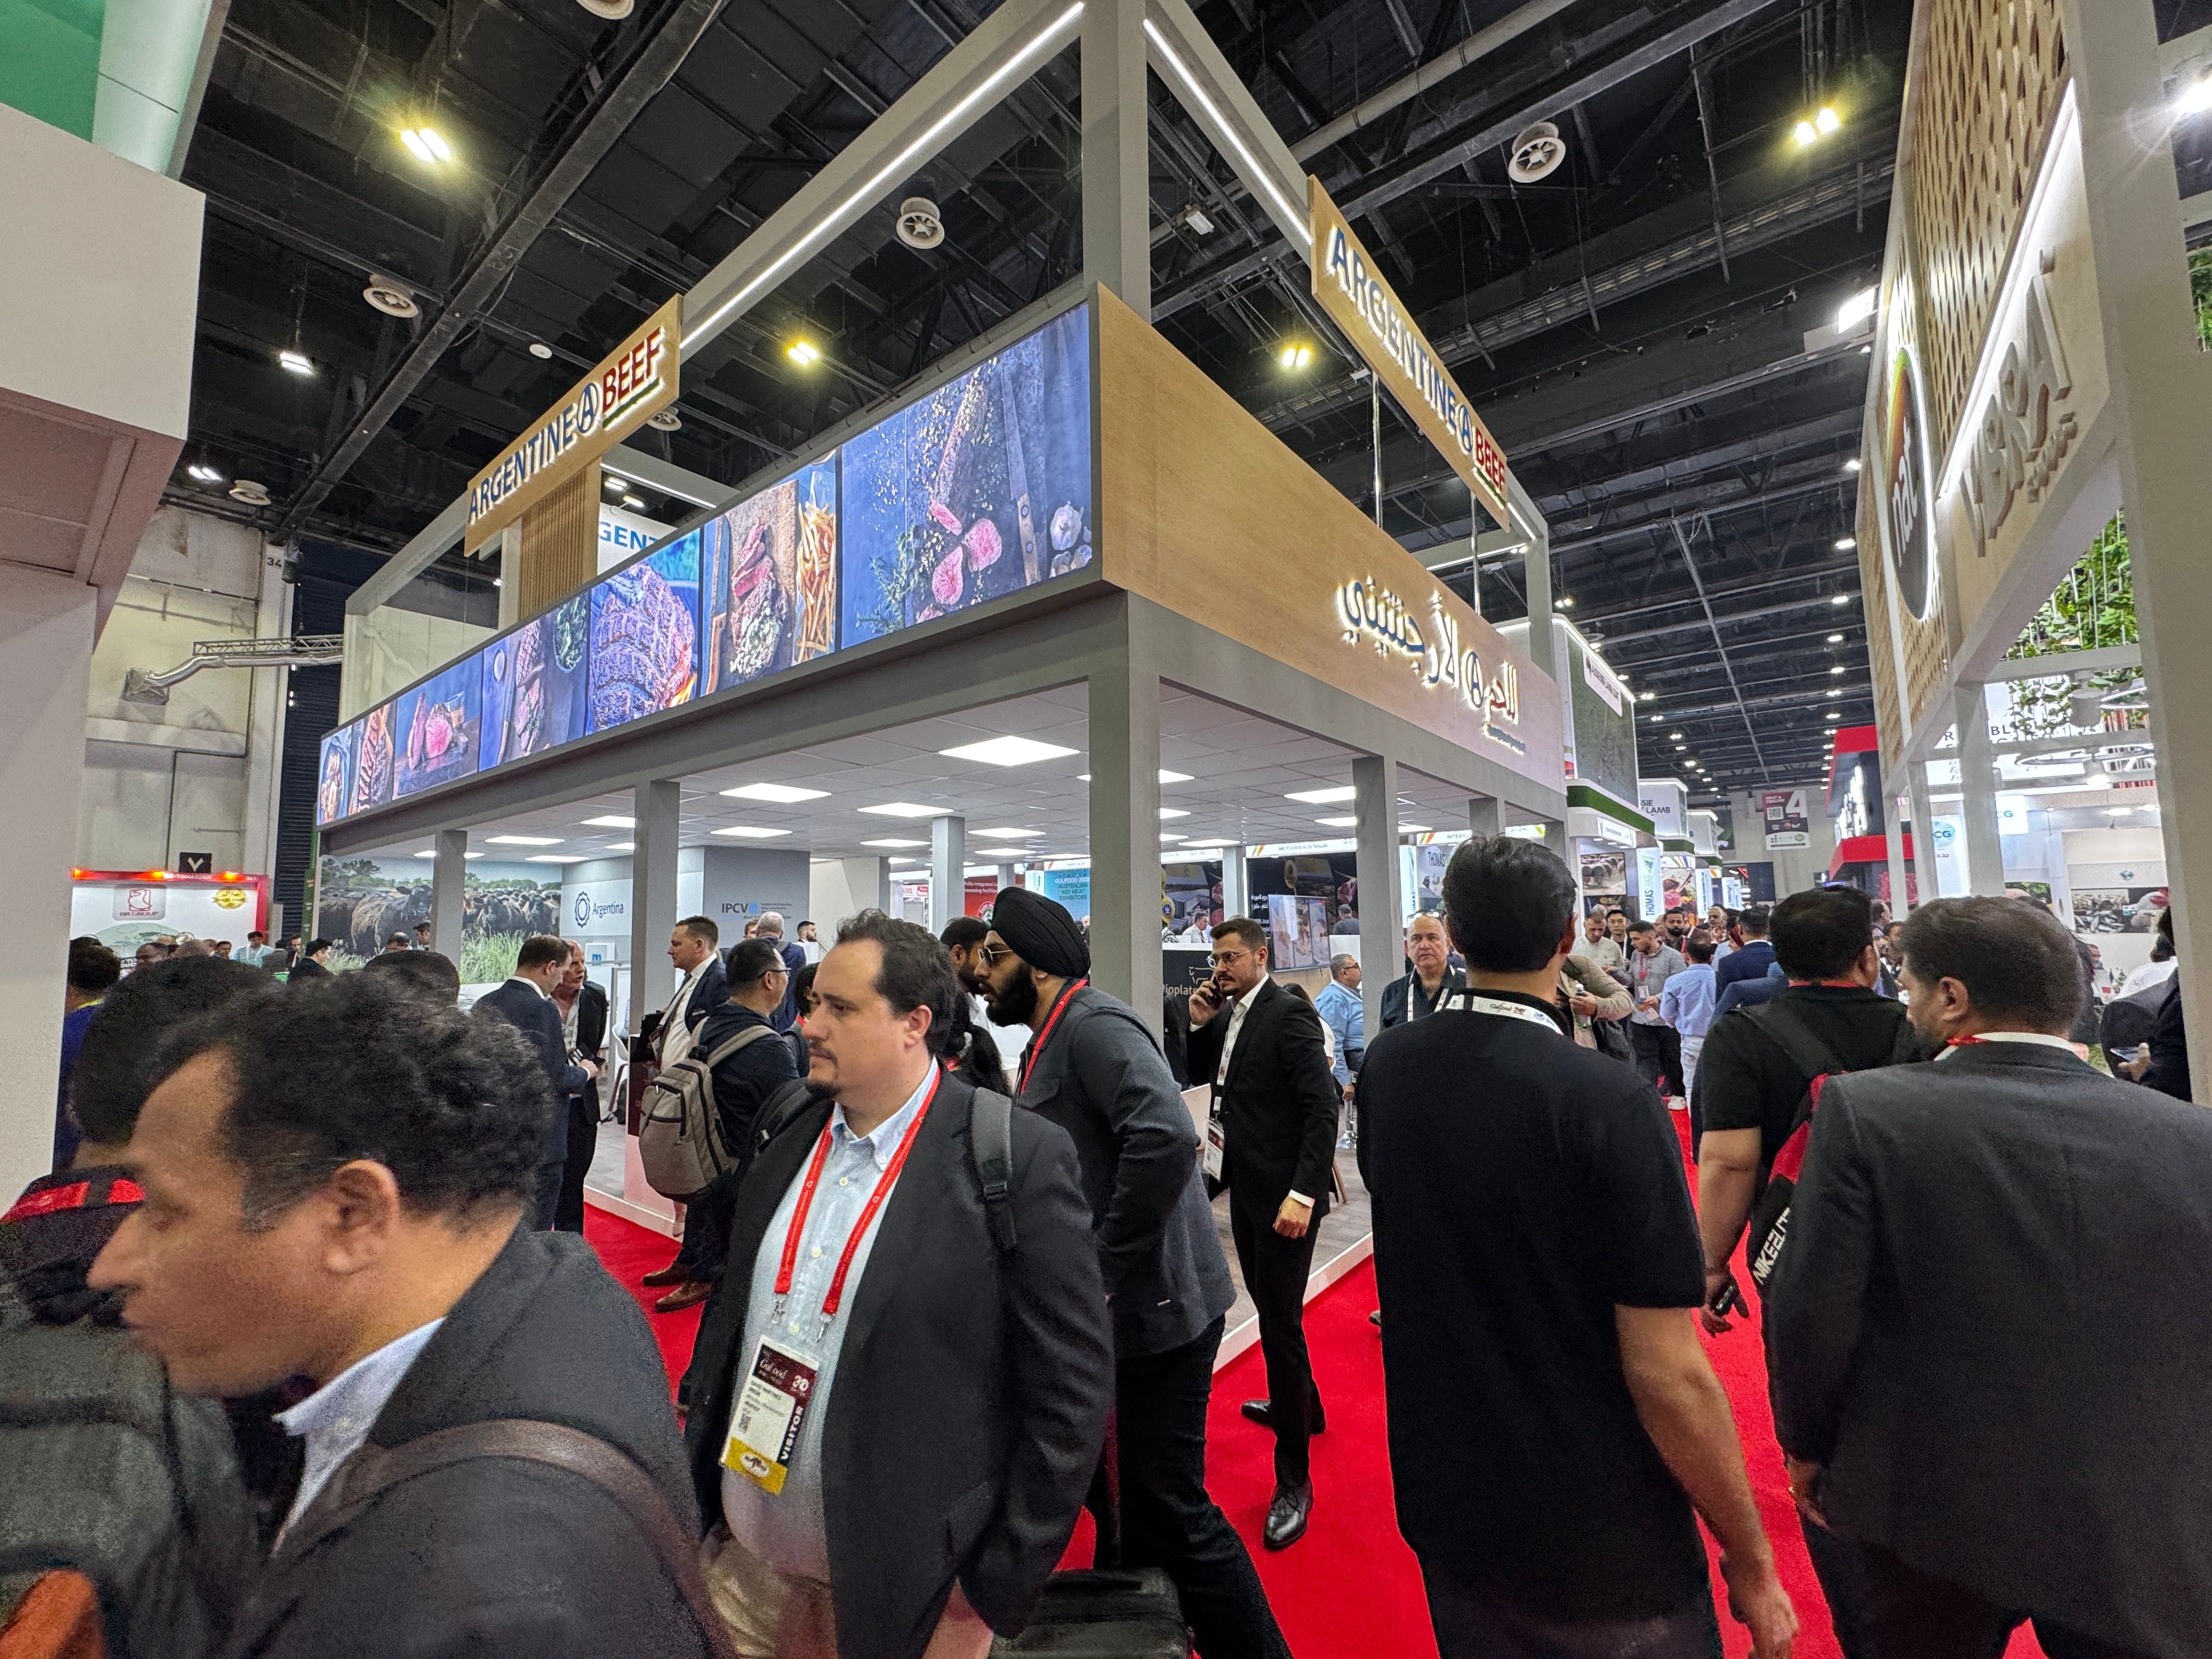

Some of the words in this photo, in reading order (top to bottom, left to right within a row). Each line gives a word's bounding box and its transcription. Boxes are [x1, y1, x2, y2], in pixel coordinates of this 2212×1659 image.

[1326, 225, 1456, 437] ARGENTINE
[1473, 425, 1506, 493] BEEF
[468, 403, 578, 526] ARGENTINE
[603, 325, 665, 416] BEEF
[1893, 416, 1918, 567] nat
[1335, 575, 1460, 690] الأرجنتيني
[1785, 790, 1808, 819] 4
[1427, 851, 1446, 868] THOMAS
[592, 900, 624, 918] Argentina
[722, 903, 748, 913] IPCV
[1644, 889, 1655, 916] THOMAS
[781, 1406, 803, 1460] VISITOR
